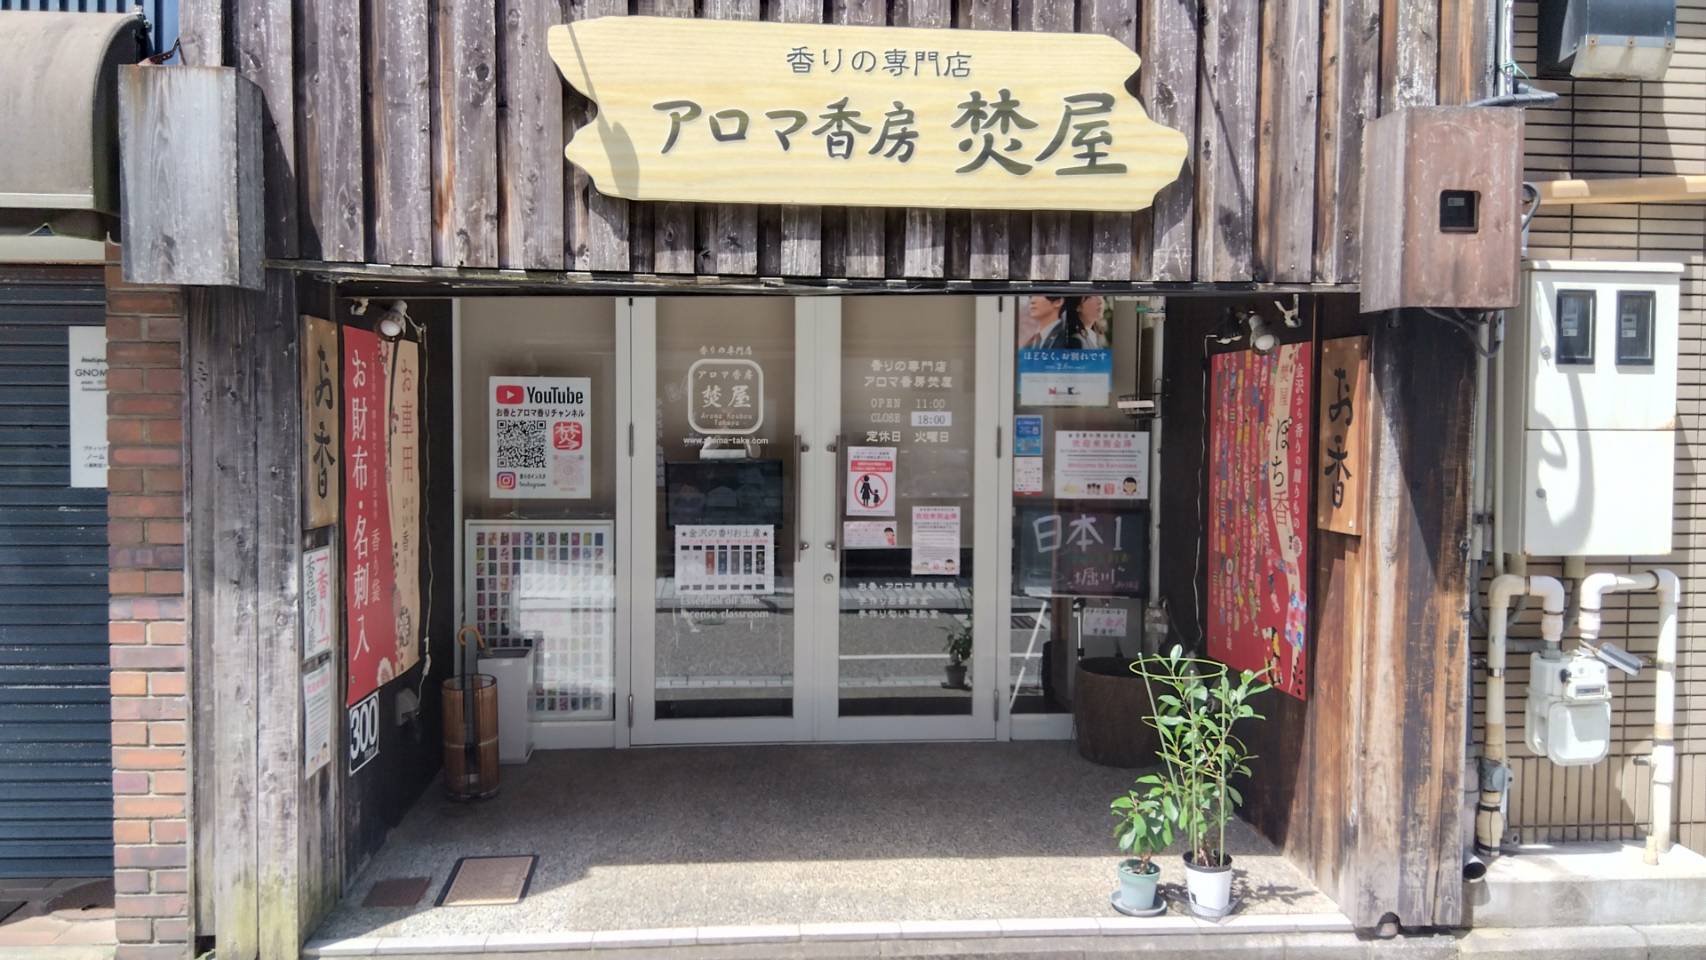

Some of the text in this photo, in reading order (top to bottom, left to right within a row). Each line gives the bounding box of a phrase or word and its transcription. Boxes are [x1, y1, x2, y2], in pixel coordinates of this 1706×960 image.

[786, 47, 972, 78] 香りの専門店
[652, 88, 1128, 176] アロマ香房 焚屋
[1024, 351, 1108, 361] ほどなく、お別れです
[871, 360, 947, 372] 香りの専門店
[526, 386, 584, 404] YouTube
[702, 385, 751, 408] 焚屋
[871, 398, 945, 408] OPEN 11:00
[496, 408, 585, 418] お香とアロマ香りチャンネル
[871, 412, 946, 425] CLOSE 18:00
[313, 344, 336, 500] お香
[866, 431, 949, 442] 定休日 火曜日
[1324, 367, 1354, 510] お香
[688, 528, 761, 538] 金沢の香りお土産
[720, 608, 769, 618] classroom
[350, 698, 377, 760] 300
